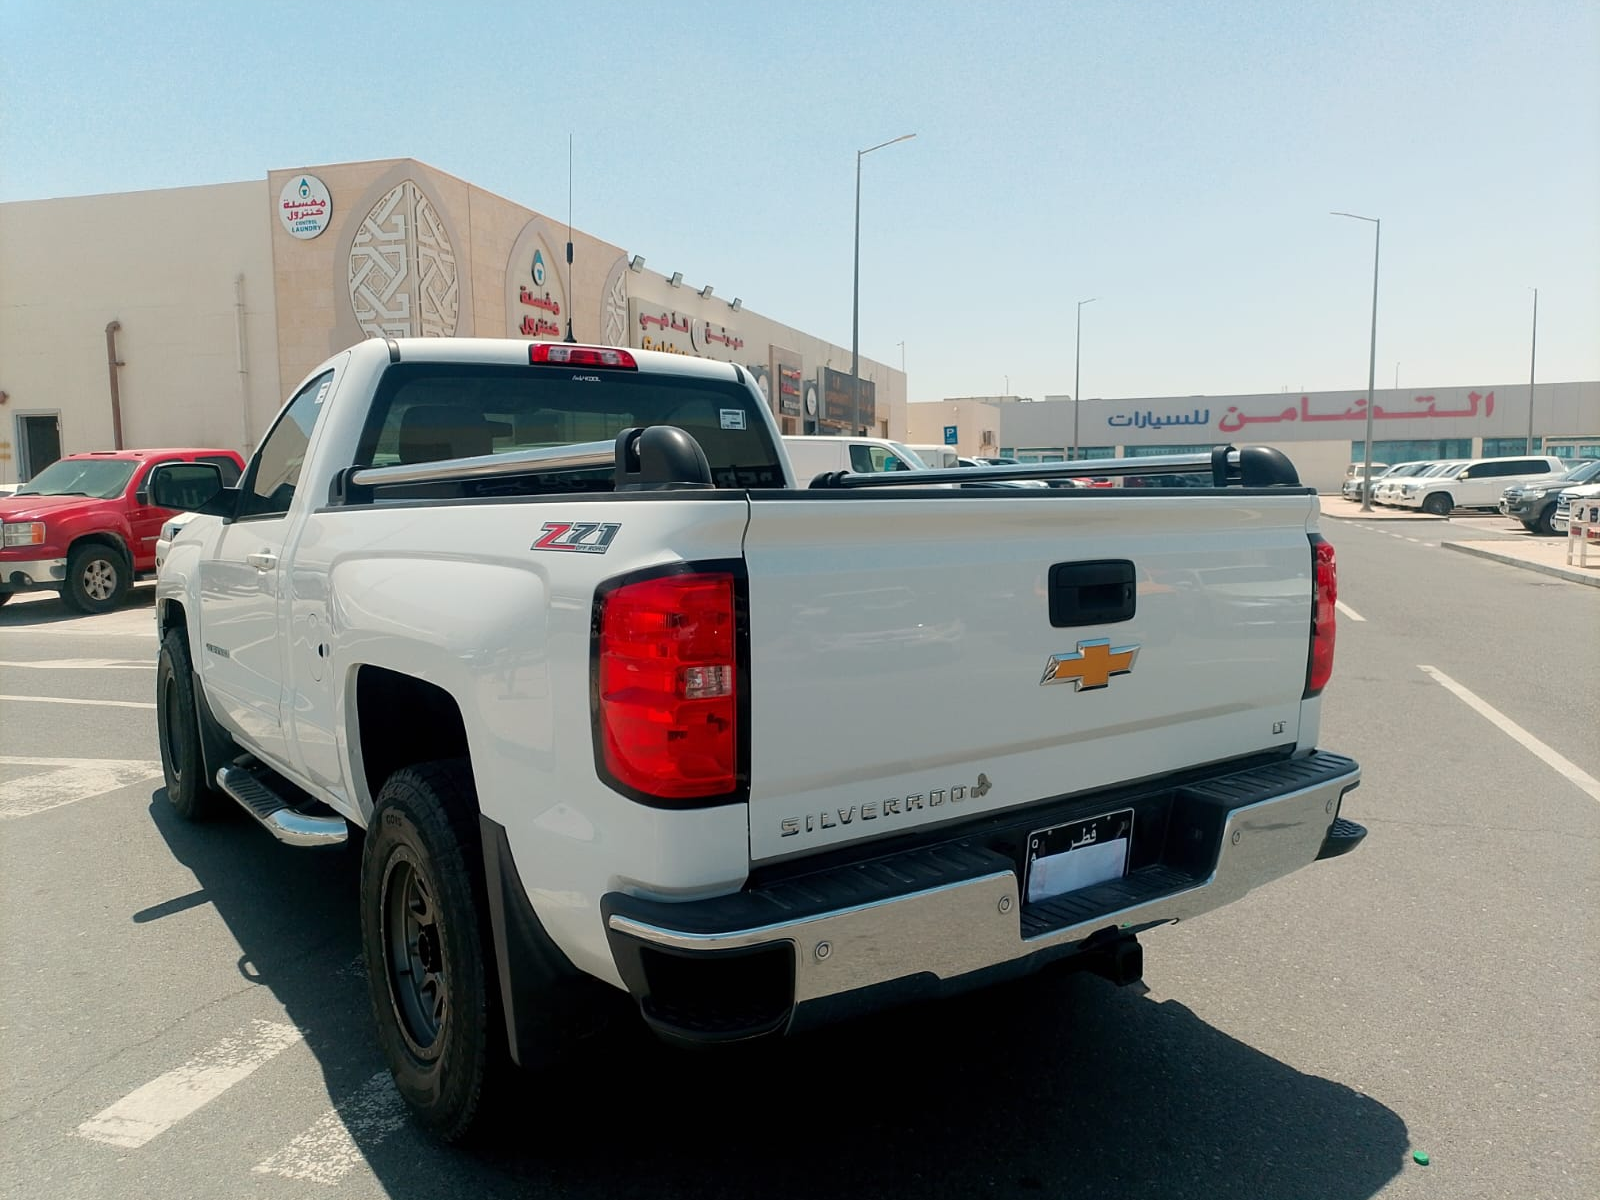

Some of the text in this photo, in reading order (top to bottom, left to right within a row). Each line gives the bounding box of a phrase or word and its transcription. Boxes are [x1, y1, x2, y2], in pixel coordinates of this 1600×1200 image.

[1107, 391, 1494, 432] التضامن للسيارات
[946, 428, 955, 437] P
[531, 522, 622, 554] Z71
[781, 784, 967, 837] SILVERADO
[1069, 823, 1097, 852] قطر
